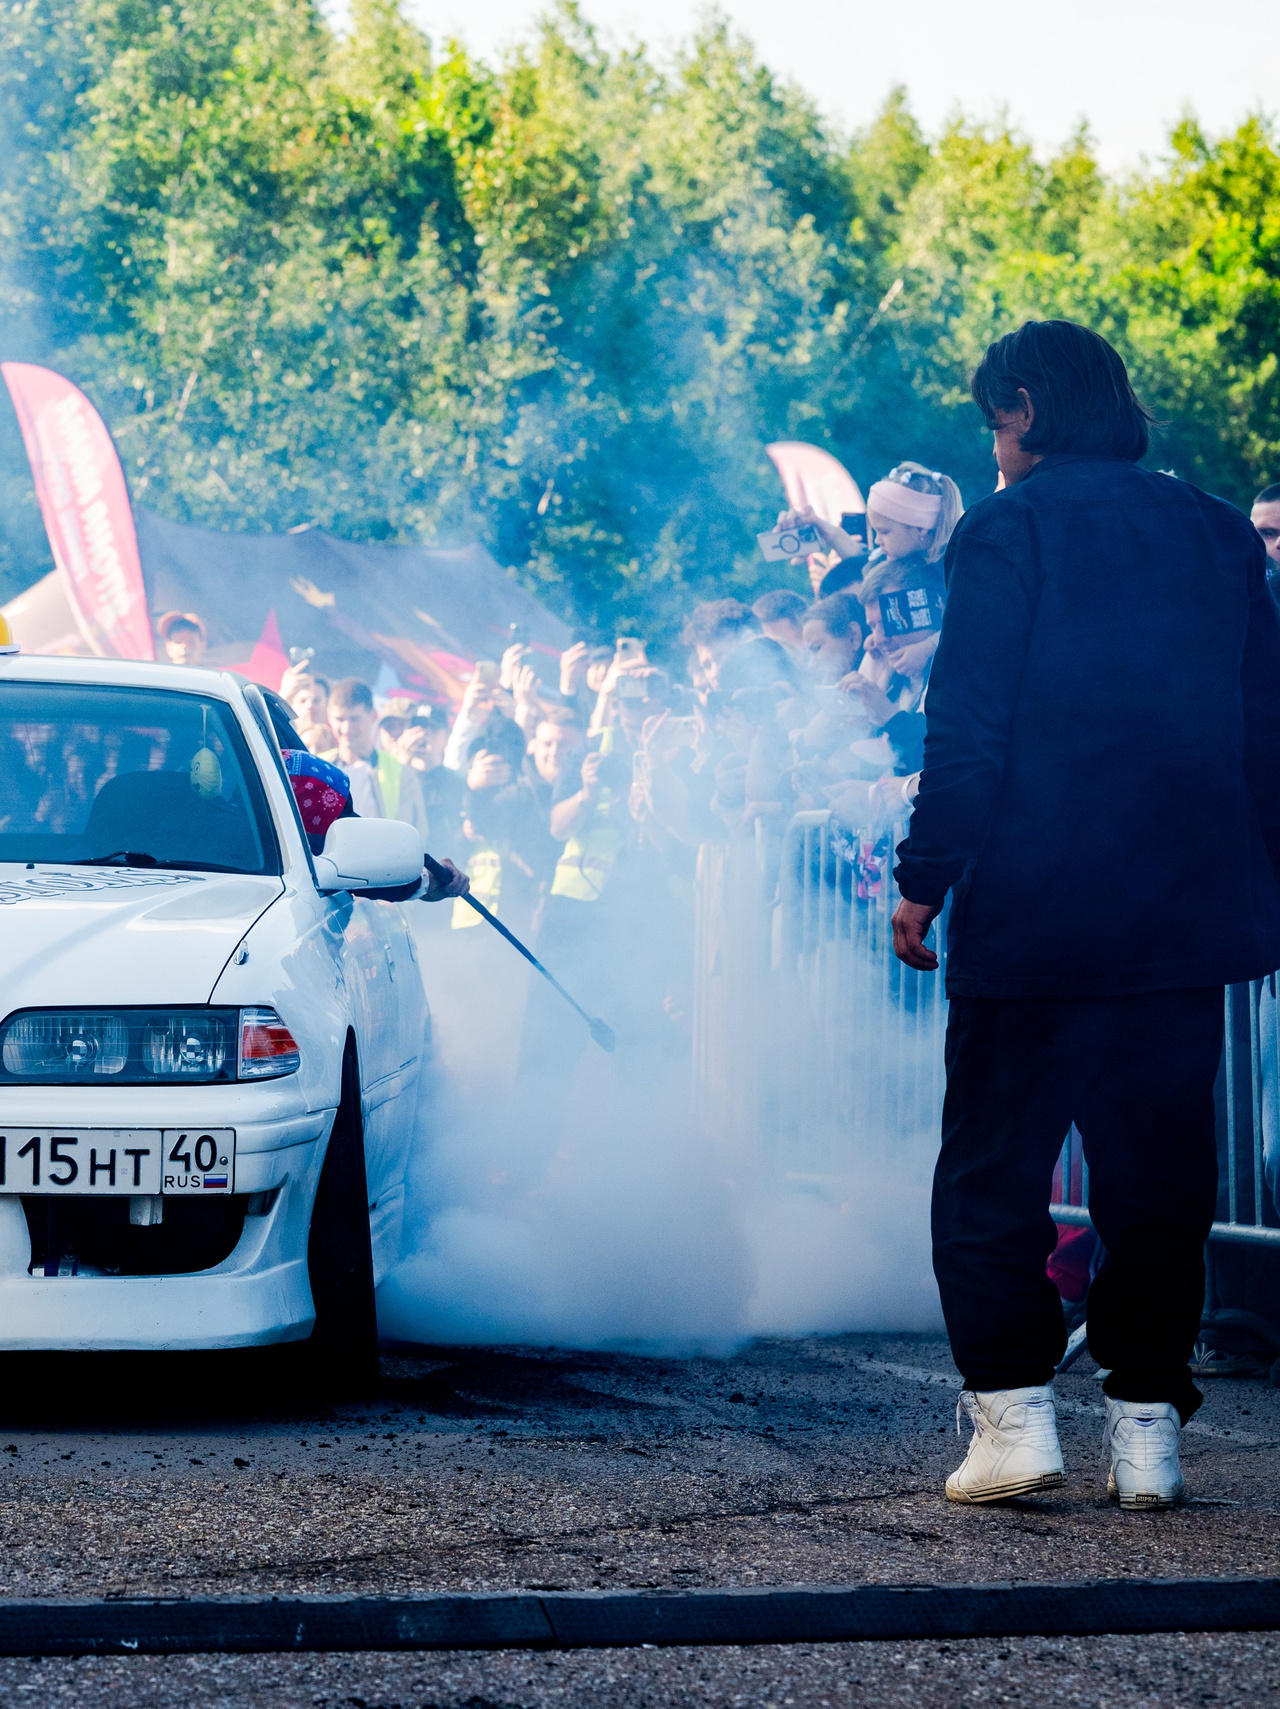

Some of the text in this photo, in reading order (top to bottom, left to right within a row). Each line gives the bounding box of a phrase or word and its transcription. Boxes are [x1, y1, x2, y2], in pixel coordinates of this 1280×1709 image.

[168, 1134, 218, 1172] 40
[164, 1175, 201, 1189] RUS
[1136, 1495, 1158, 1503] SUPRA
